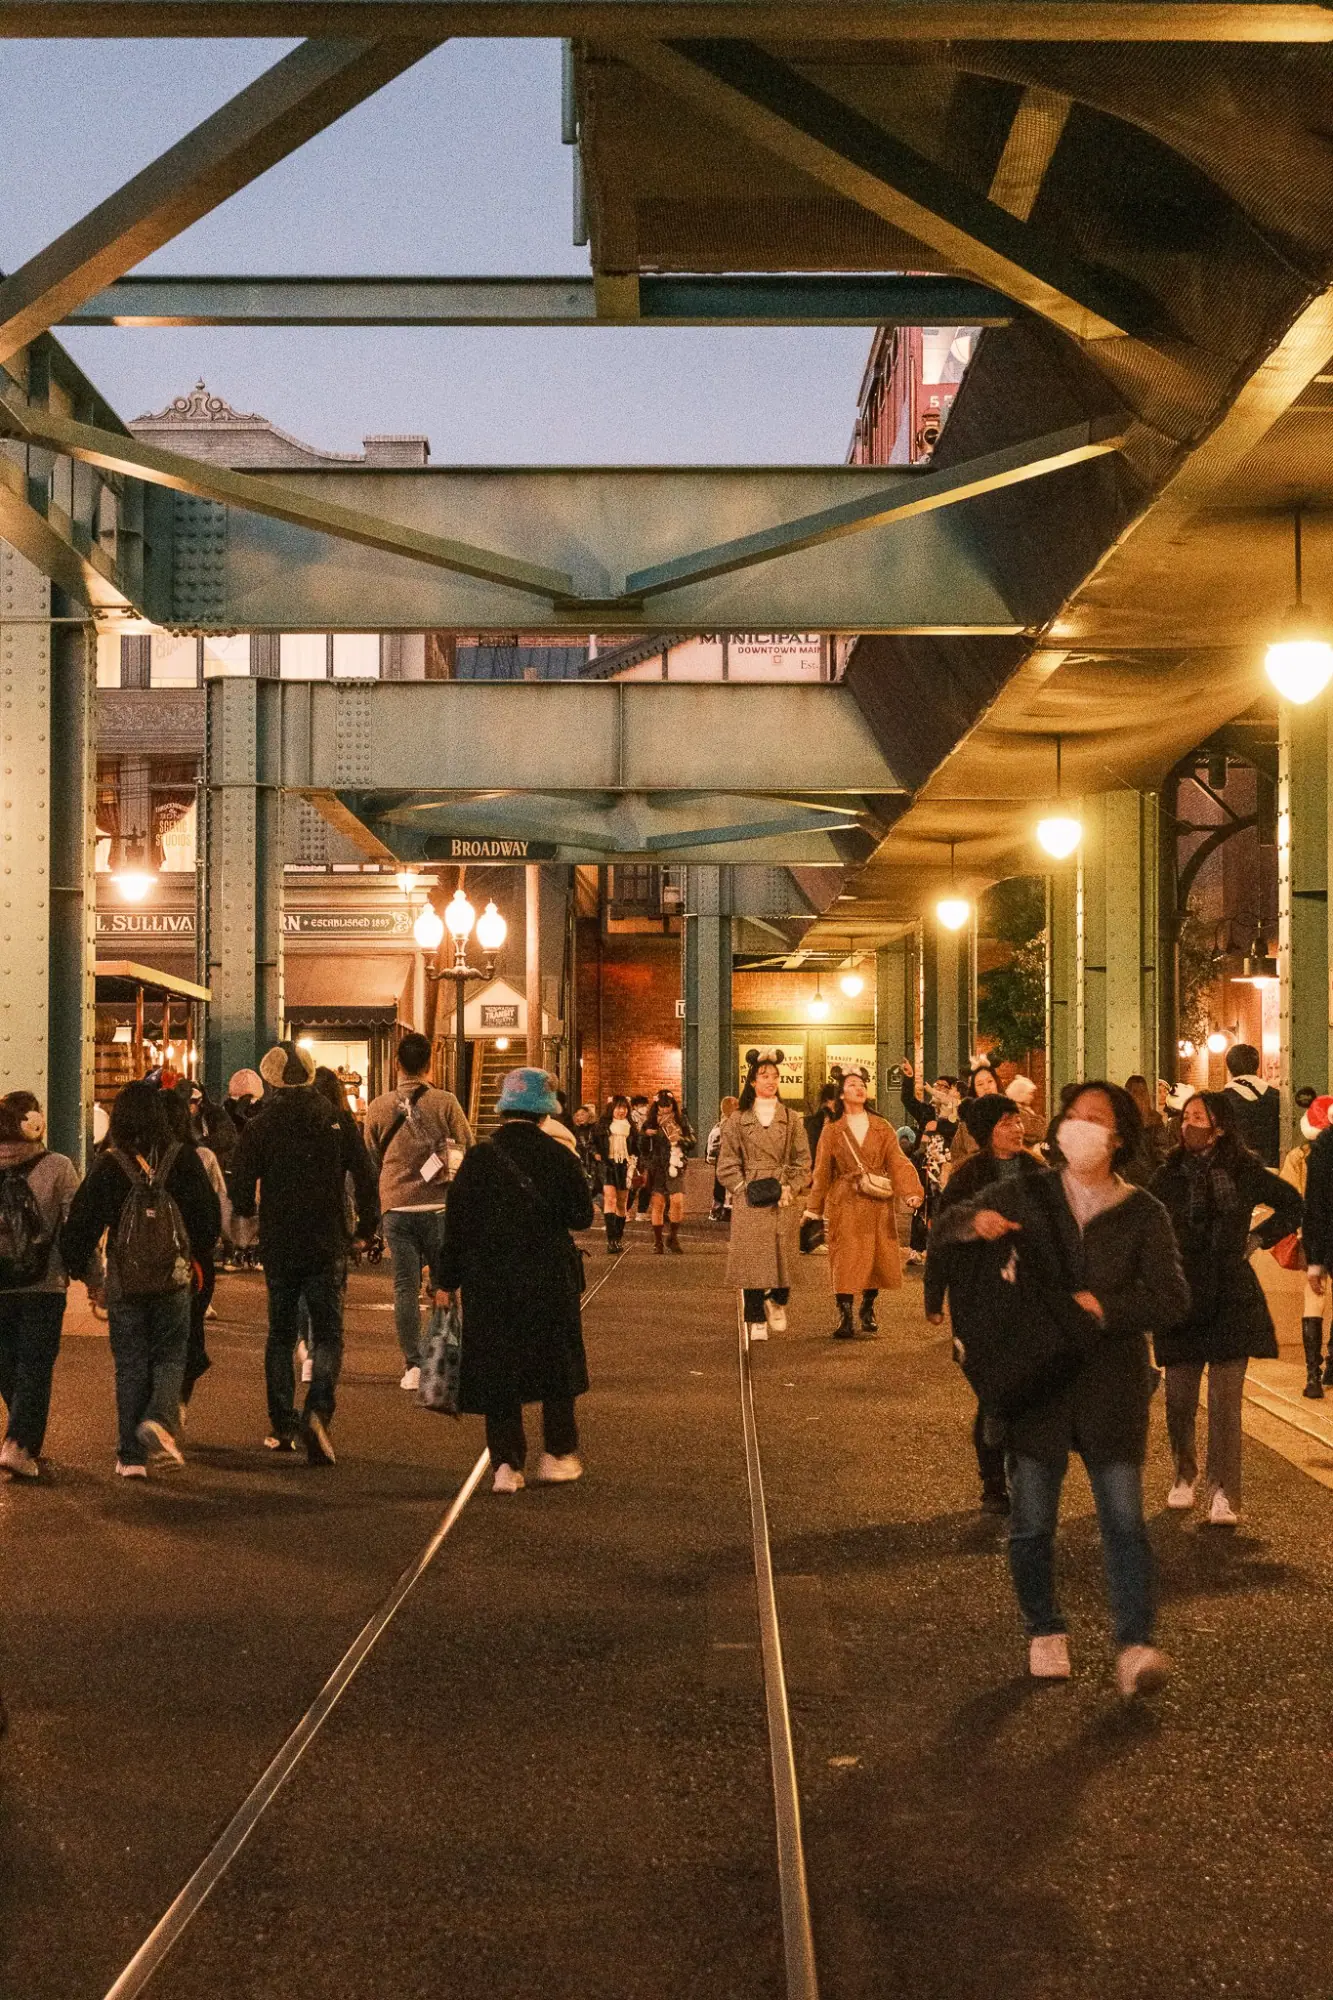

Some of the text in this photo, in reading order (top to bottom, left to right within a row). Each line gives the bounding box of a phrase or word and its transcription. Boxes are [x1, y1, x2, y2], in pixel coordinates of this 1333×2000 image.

[160, 820, 187, 833] SCENIC
[155, 833, 192, 847] STUDIOS
[451, 840, 529, 856] BROADWAY
[311, 918, 370, 928] ESTABLISHED
